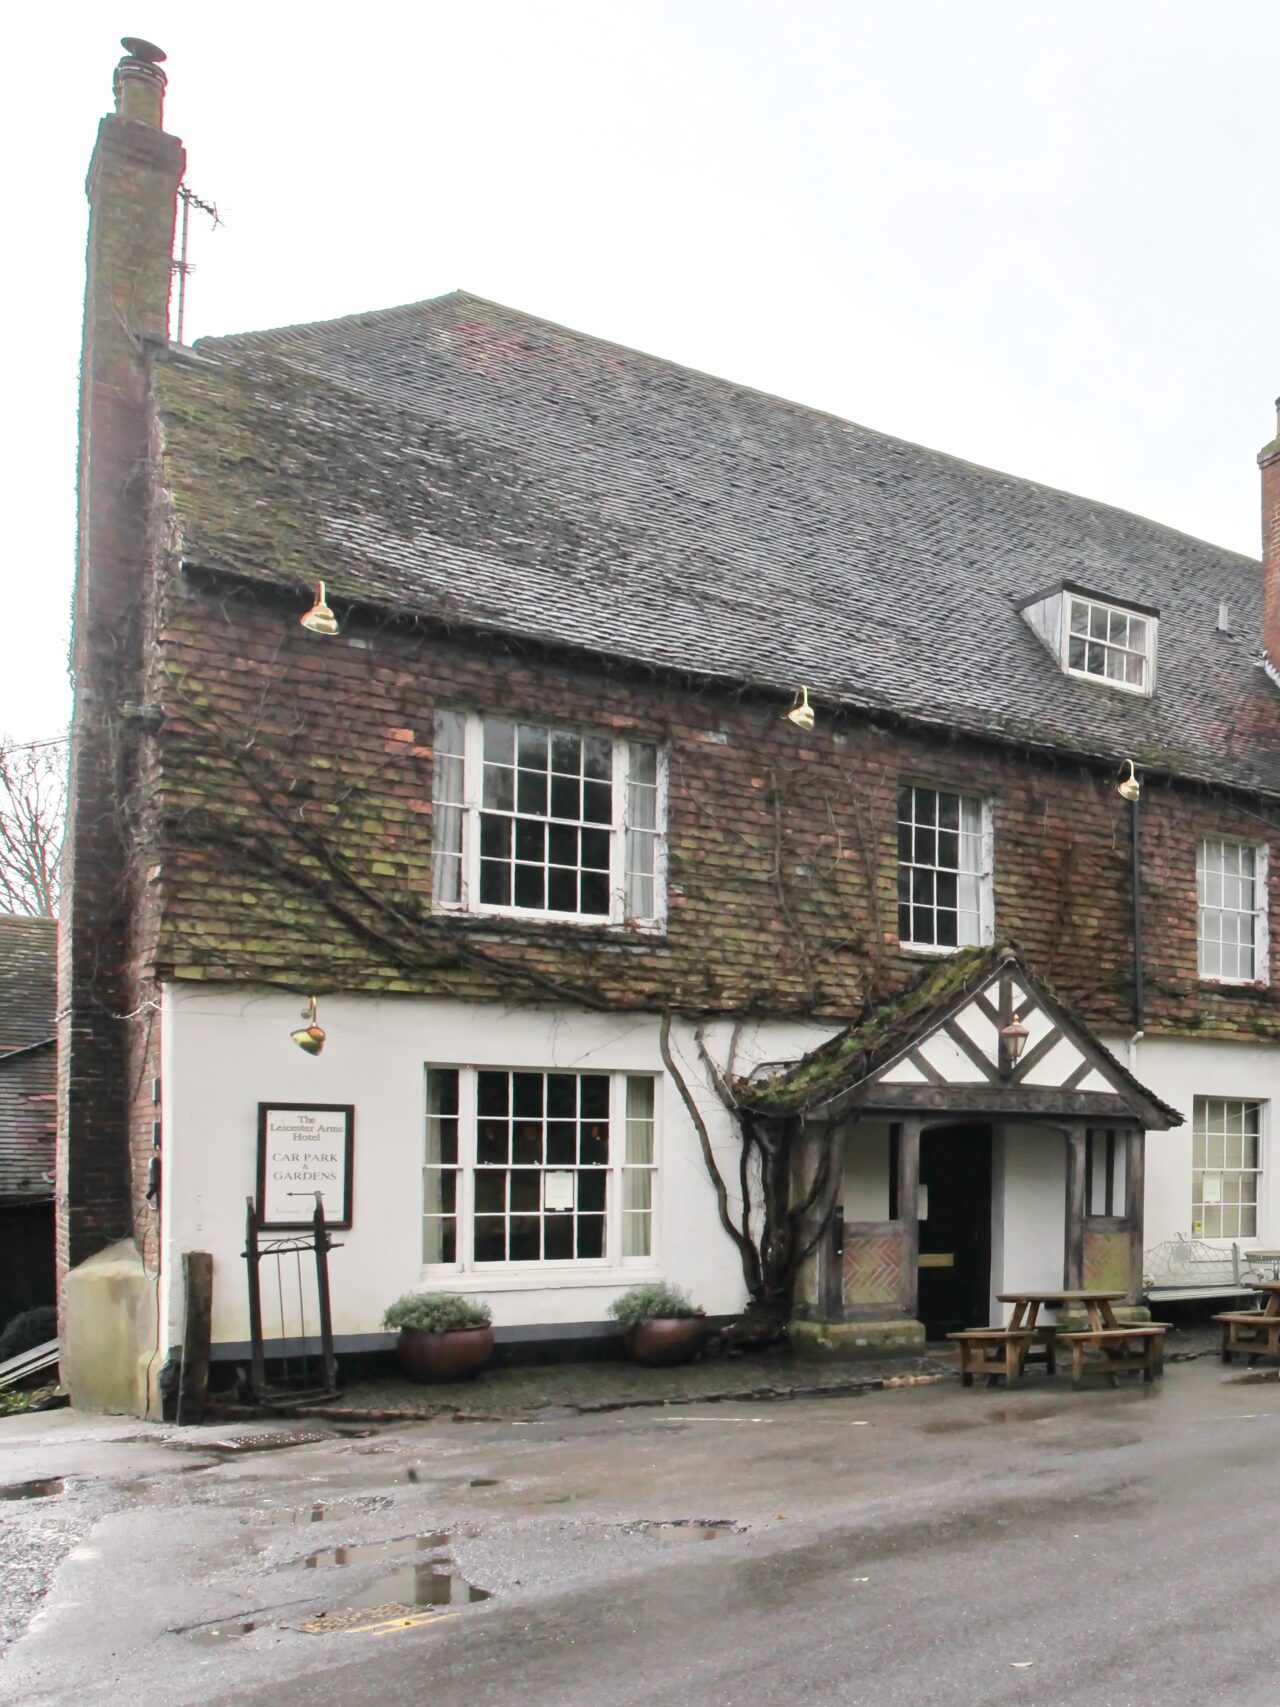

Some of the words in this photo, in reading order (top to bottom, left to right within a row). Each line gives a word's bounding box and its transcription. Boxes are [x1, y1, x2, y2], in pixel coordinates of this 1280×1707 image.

[297, 1115, 316, 1124] The
[270, 1123, 315, 1132] Leicester
[316, 1125, 344, 1133] Arms
[292, 1133, 321, 1141] Hotel
[272, 1153, 300, 1162] CAR
[304, 1153, 338, 1162] PARK
[273, 1172, 337, 1181] GARDENS
